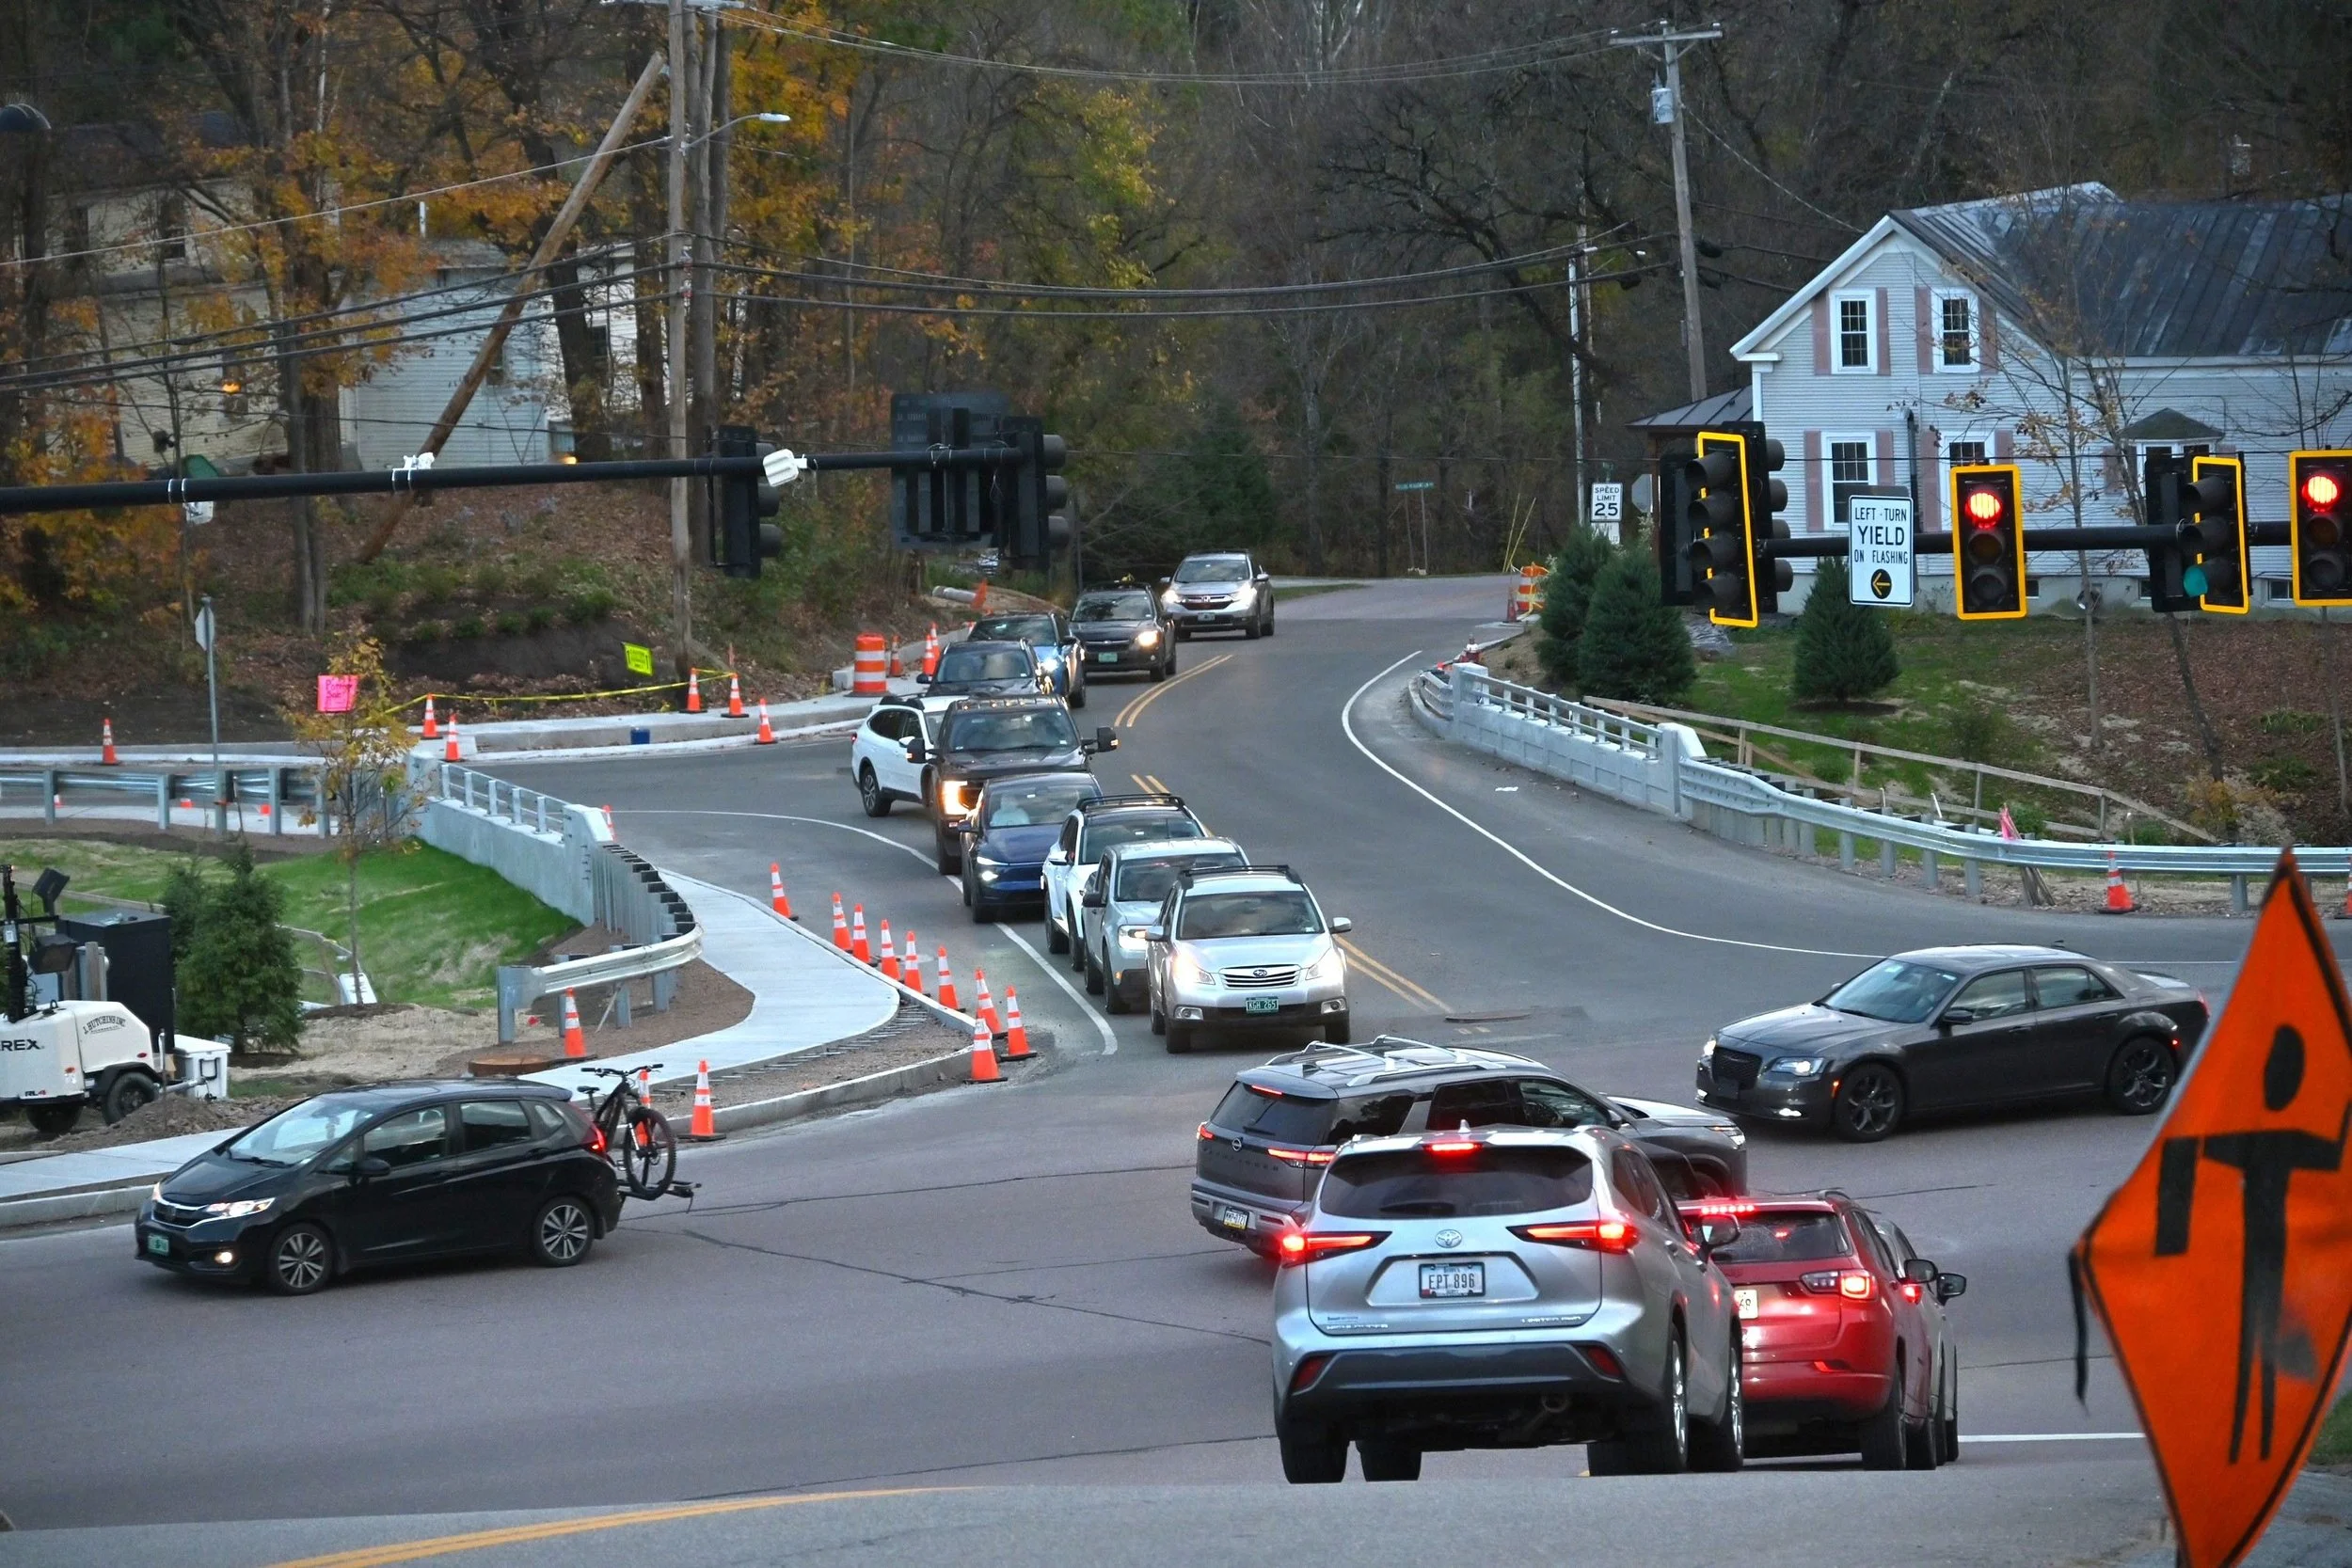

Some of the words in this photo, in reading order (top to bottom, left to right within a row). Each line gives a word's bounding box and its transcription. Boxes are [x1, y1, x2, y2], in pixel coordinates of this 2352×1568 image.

[1595, 502, 1618, 516] 25
[1854, 507, 1876, 520] LEFT
[1883, 508, 1907, 521] TURN
[1857, 525, 1905, 546] YIELD
[1854, 549, 1865, 562] ON
[1872, 550, 1908, 564] FLASHING
[0, 1038, 40, 1052] REX
[1428, 1274, 1450, 1290] EPT
[1454, 1273, 1475, 1289] 896
